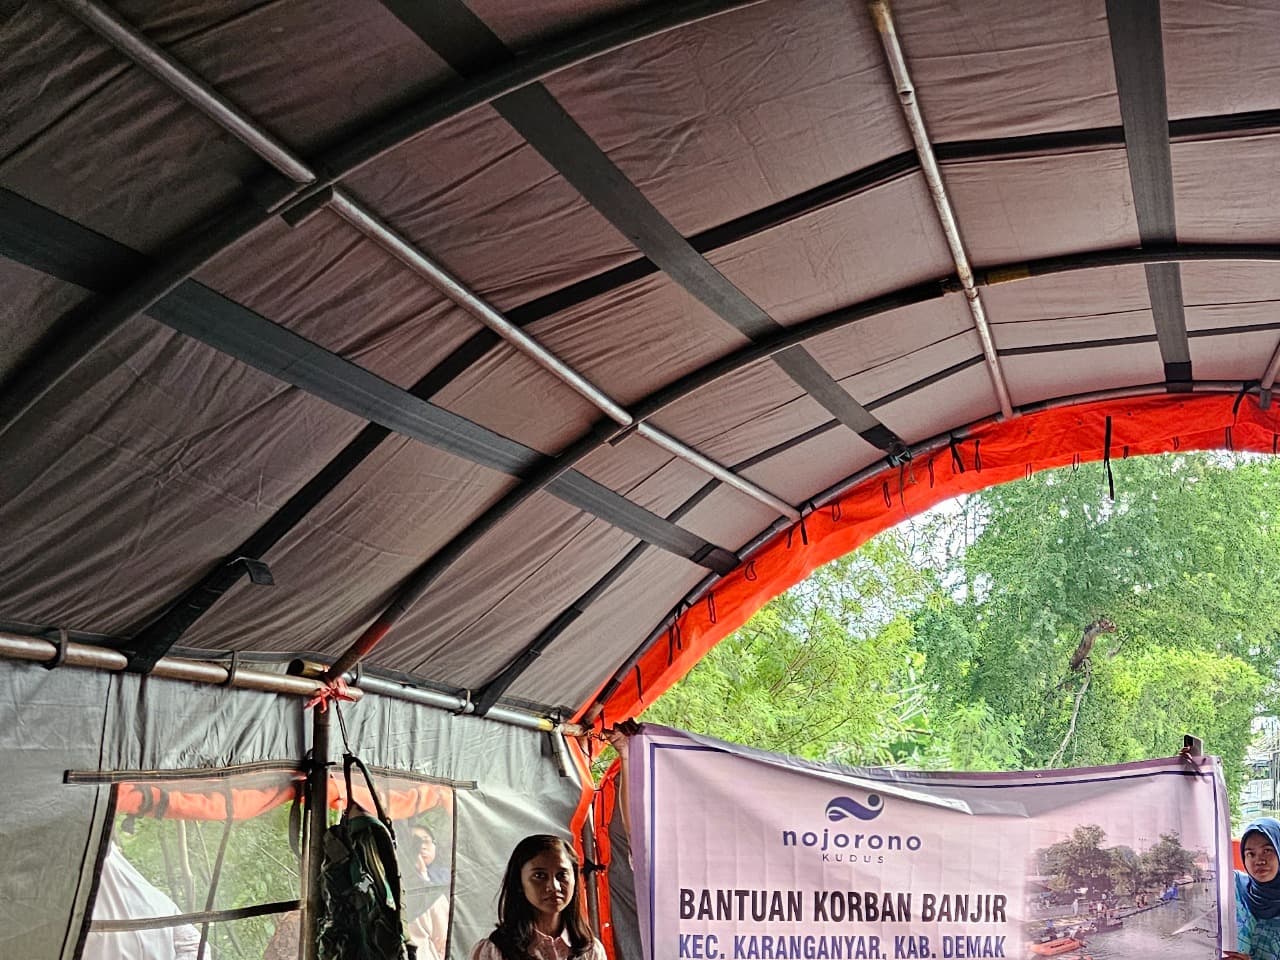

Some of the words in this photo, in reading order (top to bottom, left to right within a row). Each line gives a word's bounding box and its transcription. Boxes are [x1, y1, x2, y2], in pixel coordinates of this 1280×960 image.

[783, 828, 922, 851] nojorono
[822, 853, 885, 864] KUDUS
[679, 888, 803, 922] BANTUAN
[813, 891, 912, 923] KORBAN
[921, 893, 1007, 923] BANJIR
[679, 934, 725, 959] KEC.
[894, 936, 937, 959] KAB.
[943, 936, 1006, 959] DEMAK
